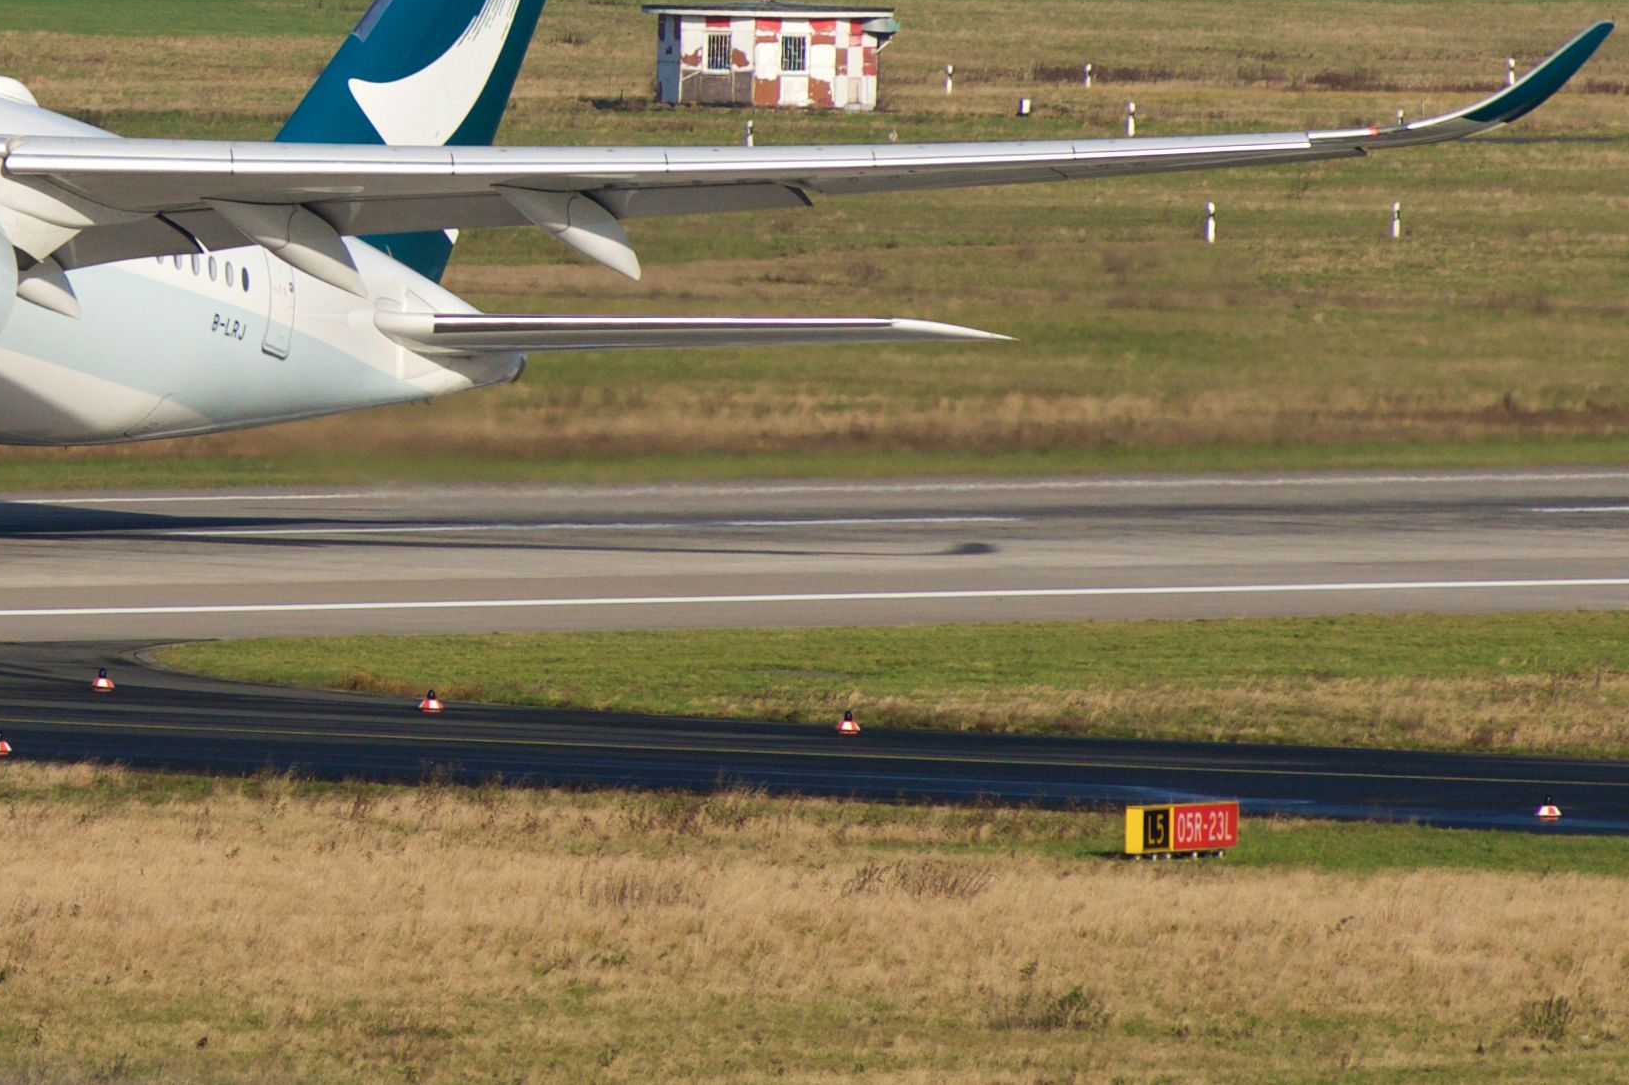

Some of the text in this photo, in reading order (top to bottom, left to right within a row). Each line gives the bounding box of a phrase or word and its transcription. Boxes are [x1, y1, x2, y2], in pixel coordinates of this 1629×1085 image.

[211, 313, 247, 341] B-LRJ
[1147, 810, 1233, 845] L5 05R-23L
